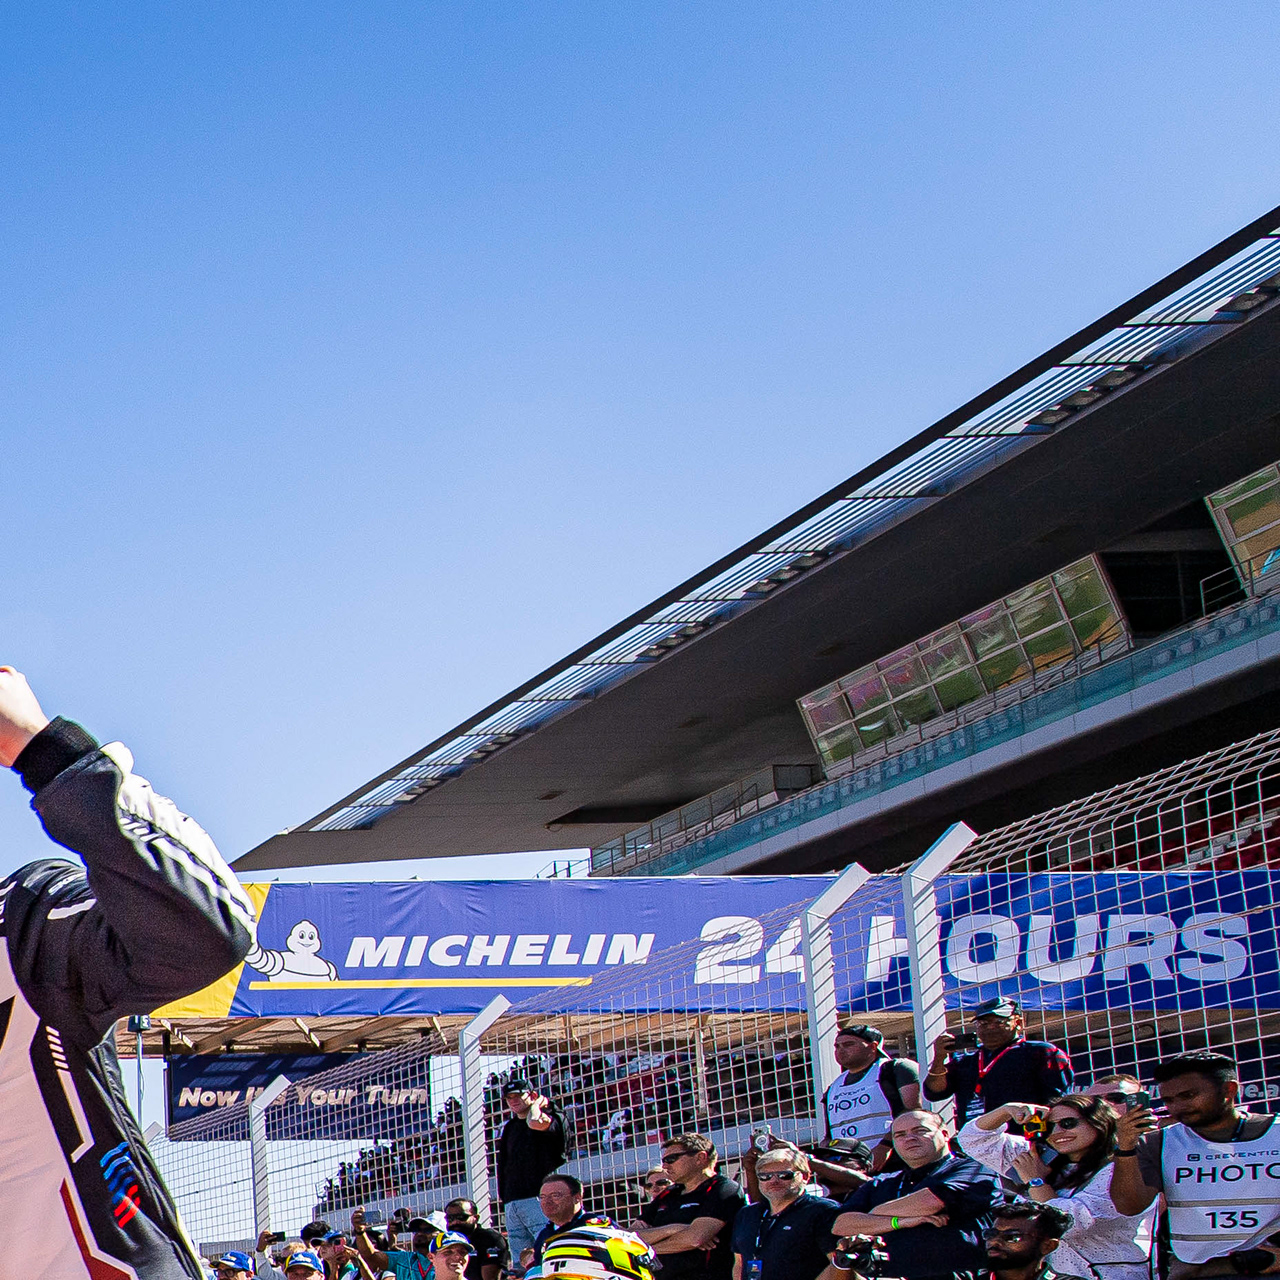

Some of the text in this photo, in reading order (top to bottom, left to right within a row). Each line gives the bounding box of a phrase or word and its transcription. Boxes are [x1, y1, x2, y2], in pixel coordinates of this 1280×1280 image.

[345, 934, 655, 968] MICHELIN
[694, 913, 1249, 985] 24 HOURS
[178, 1086, 427, 1107] Now Its Your Turn
[829, 1094, 870, 1113] PHOTO
[1205, 1211, 1259, 1229] 135
